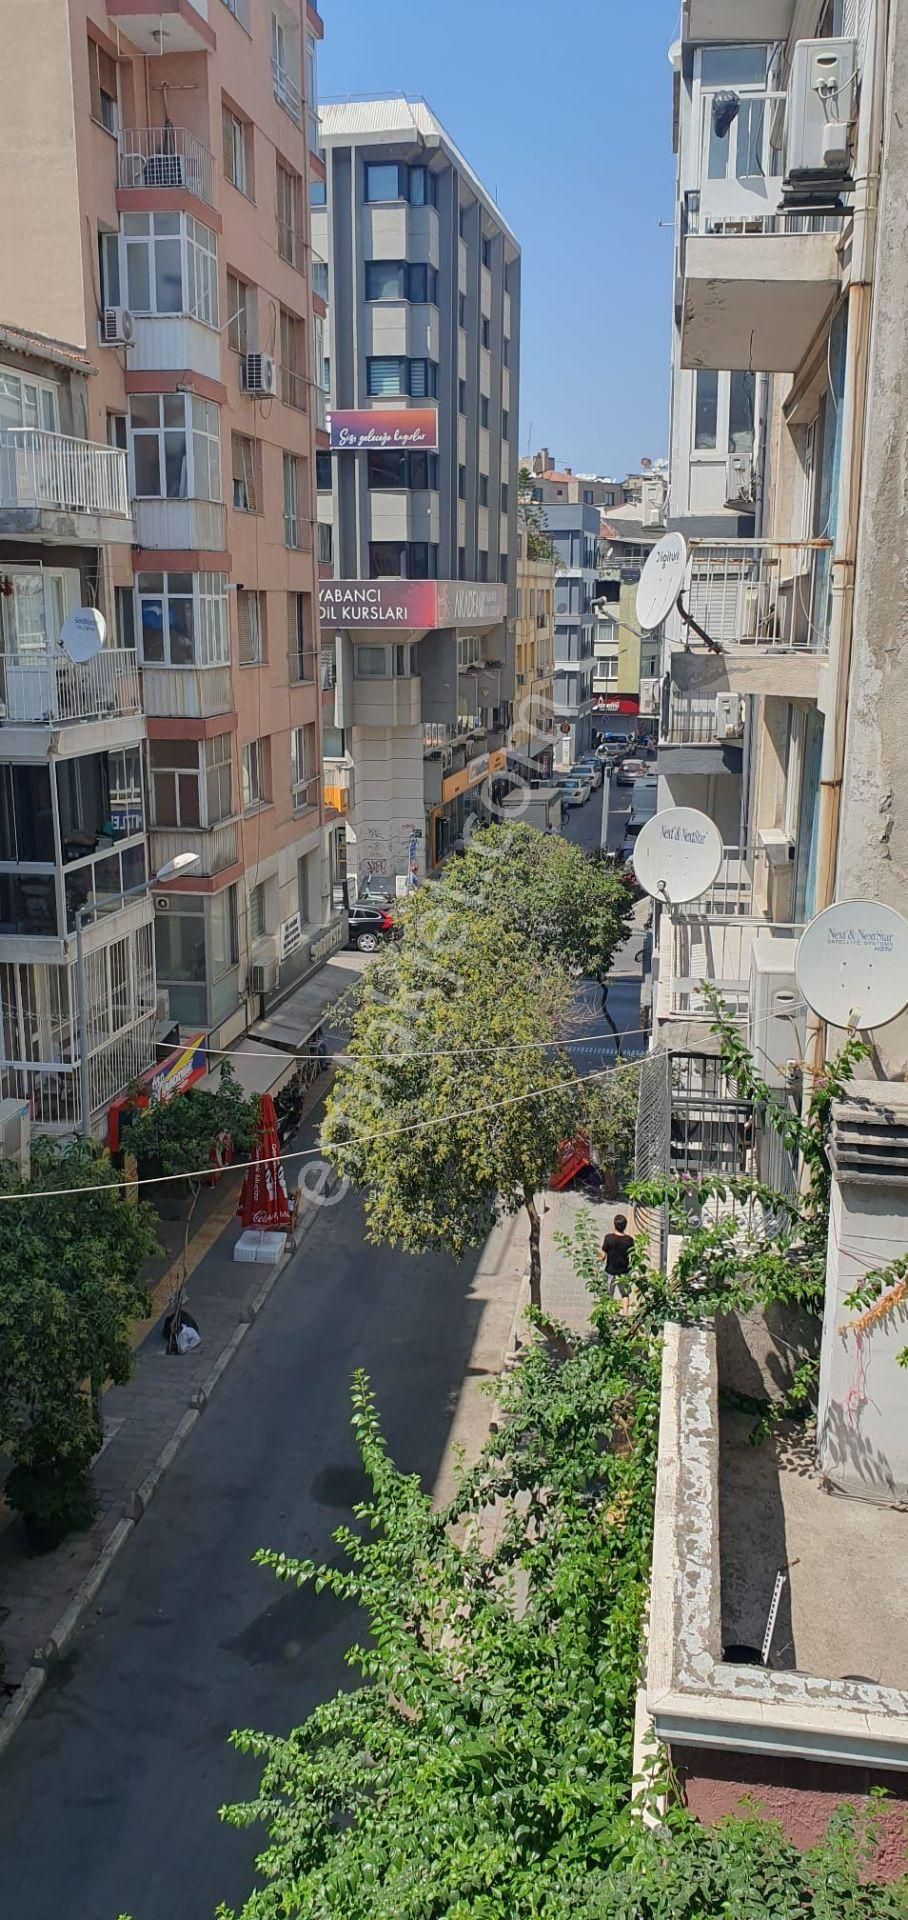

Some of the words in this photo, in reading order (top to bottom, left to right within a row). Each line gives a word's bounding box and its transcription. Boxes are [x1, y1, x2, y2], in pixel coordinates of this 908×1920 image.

[319, 589, 381, 602] YABANCI
[342, 606, 408, 620] KURSLARI
[828, 928, 846, 940] Next
[847, 929, 855, 940] &
[858, 929, 895, 942] NextStar
